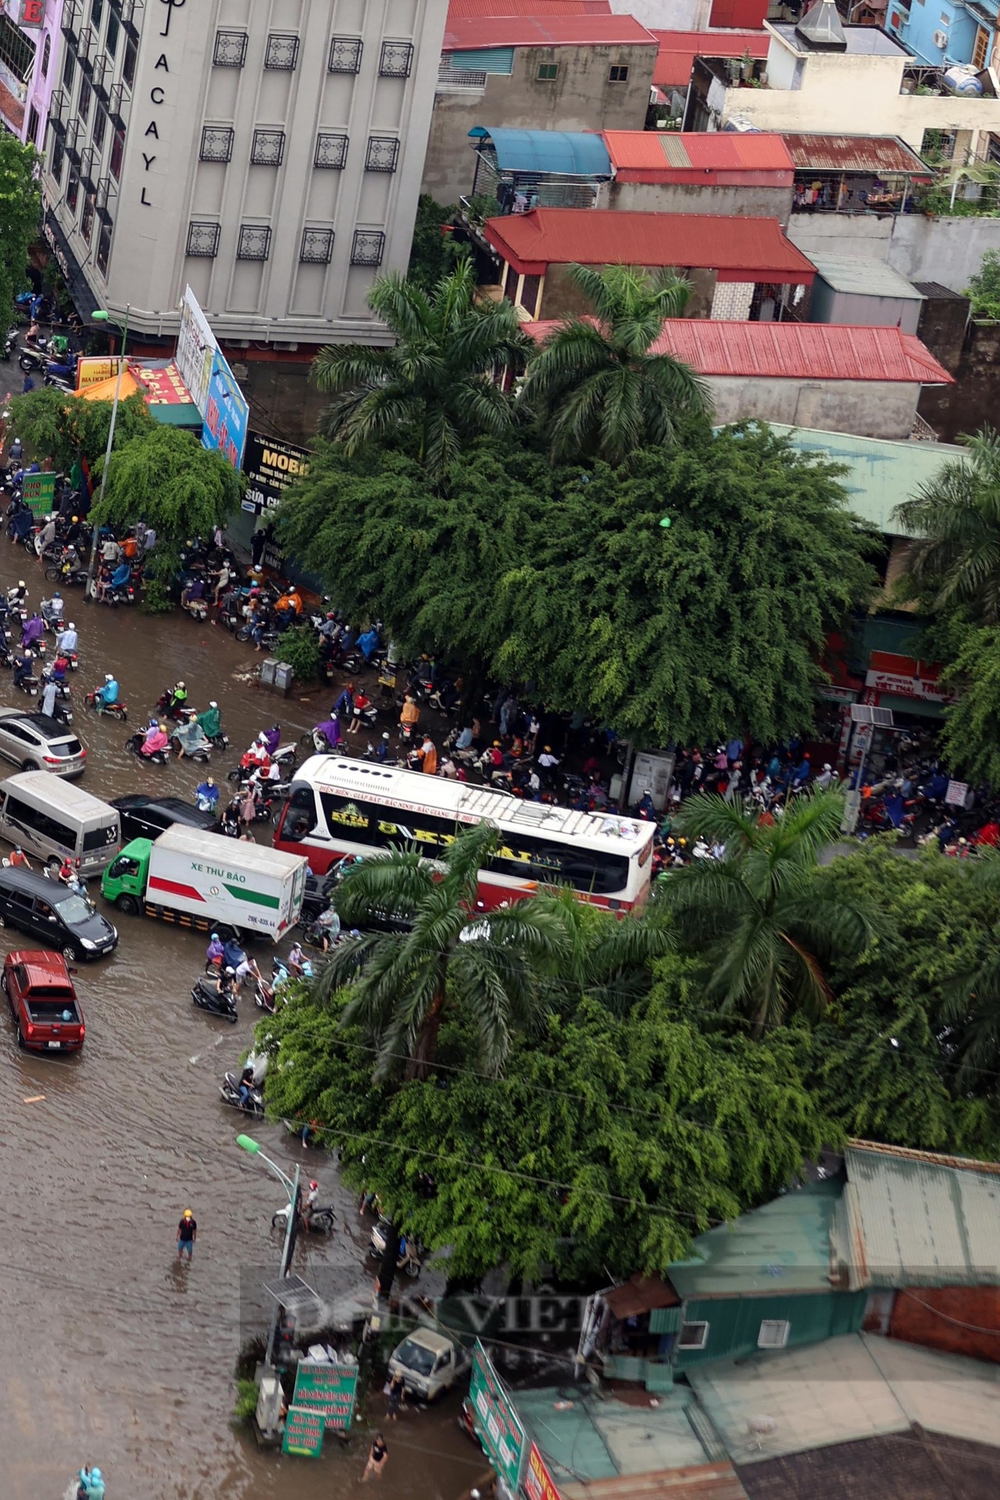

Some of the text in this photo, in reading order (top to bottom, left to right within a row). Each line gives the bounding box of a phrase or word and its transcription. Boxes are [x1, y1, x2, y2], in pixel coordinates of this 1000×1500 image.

[245, 487, 264, 505] SỬA
[886, 676, 914, 686] HONDA
[399, 802, 414, 810] NINH
[191, 862, 246, 883] XE THƯ BÁO
